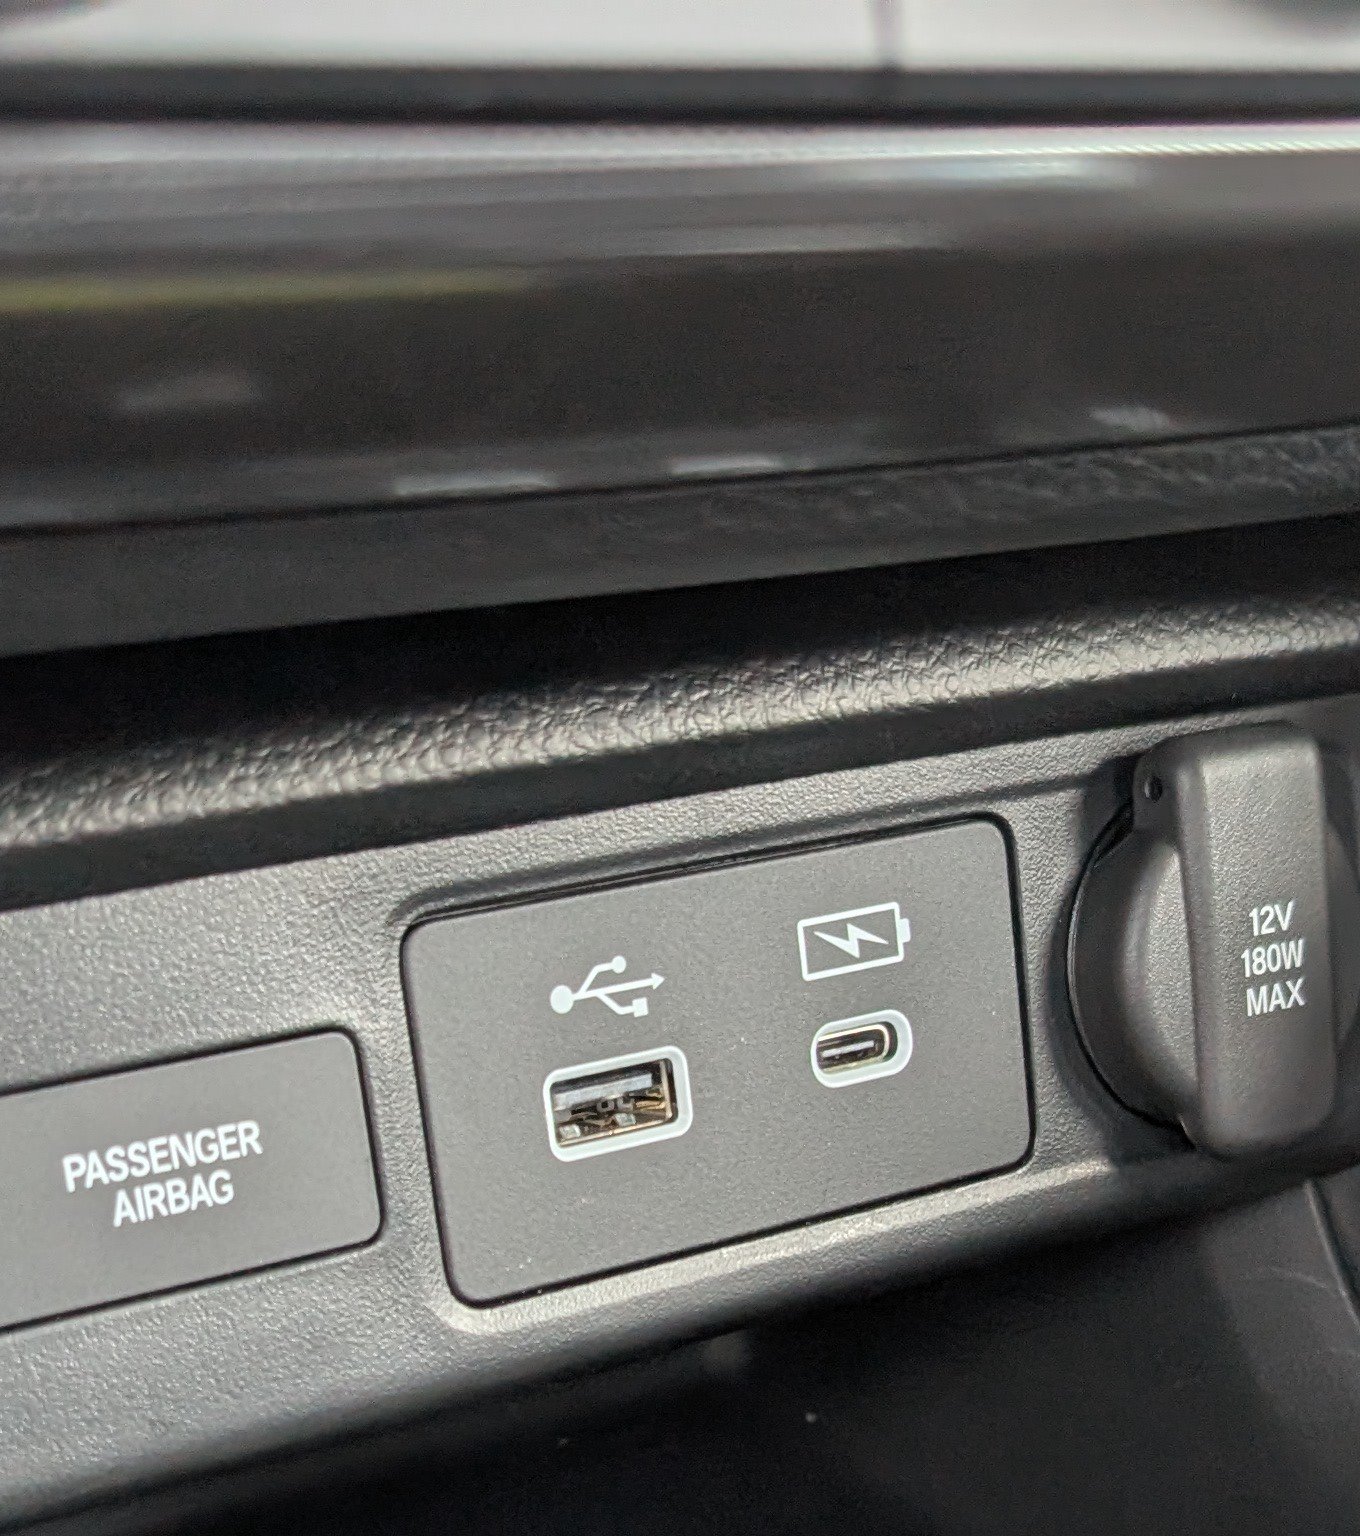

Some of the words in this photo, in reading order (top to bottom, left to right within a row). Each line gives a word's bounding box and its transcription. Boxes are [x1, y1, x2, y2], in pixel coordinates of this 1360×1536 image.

[1249, 900, 1294, 936] 12V
[1241, 938, 1304, 977] 180W
[1246, 977, 1305, 1017] MAX
[62, 1120, 263, 1193] PASSENGER
[113, 1169, 234, 1228] AIRBAG
